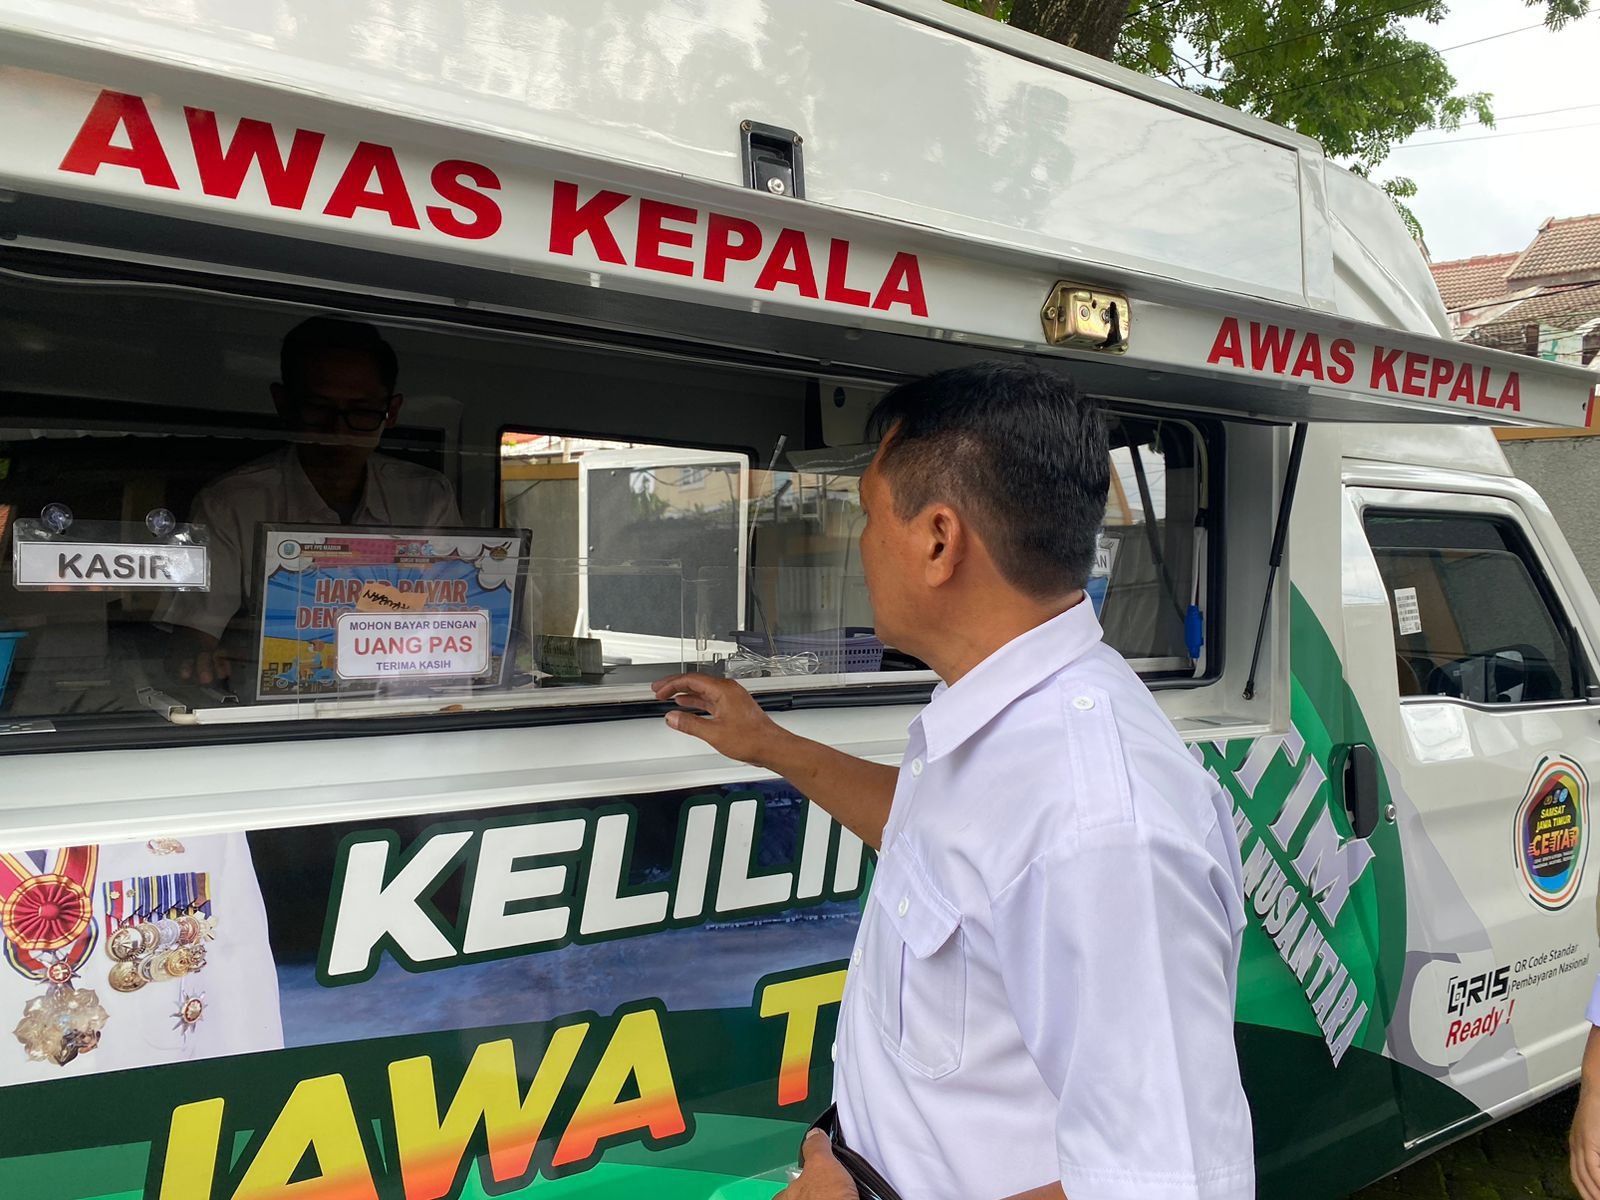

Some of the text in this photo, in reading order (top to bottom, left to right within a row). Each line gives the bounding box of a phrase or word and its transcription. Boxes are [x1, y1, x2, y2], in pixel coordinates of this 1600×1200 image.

[58, 89, 929, 317] AWAS KEPALA
[1207, 316, 1521, 412] AWAS KEPALA
[58, 553, 172, 579] KASIR
[315, 577, 391, 604] HAR
[350, 620, 477, 631] MOHON BAYAR DENGAN
[354, 636, 473, 656] UANG PAS
[376, 660, 451, 671] TERIMA KASIH
[1211, 720, 1376, 928] TIM
[1535, 814, 1571, 833] JAWA TIMUR
[1540, 805, 1566, 819] SAMSAT
[1243, 837, 1368, 1069] NUSANTARA
[1514, 943, 1579, 974] QR Code Standar
[1510, 954, 1590, 992] Pembayaran Nasional
[1447, 965, 1511, 1017] QRIS
[1445, 1006, 1504, 1048] Ready
